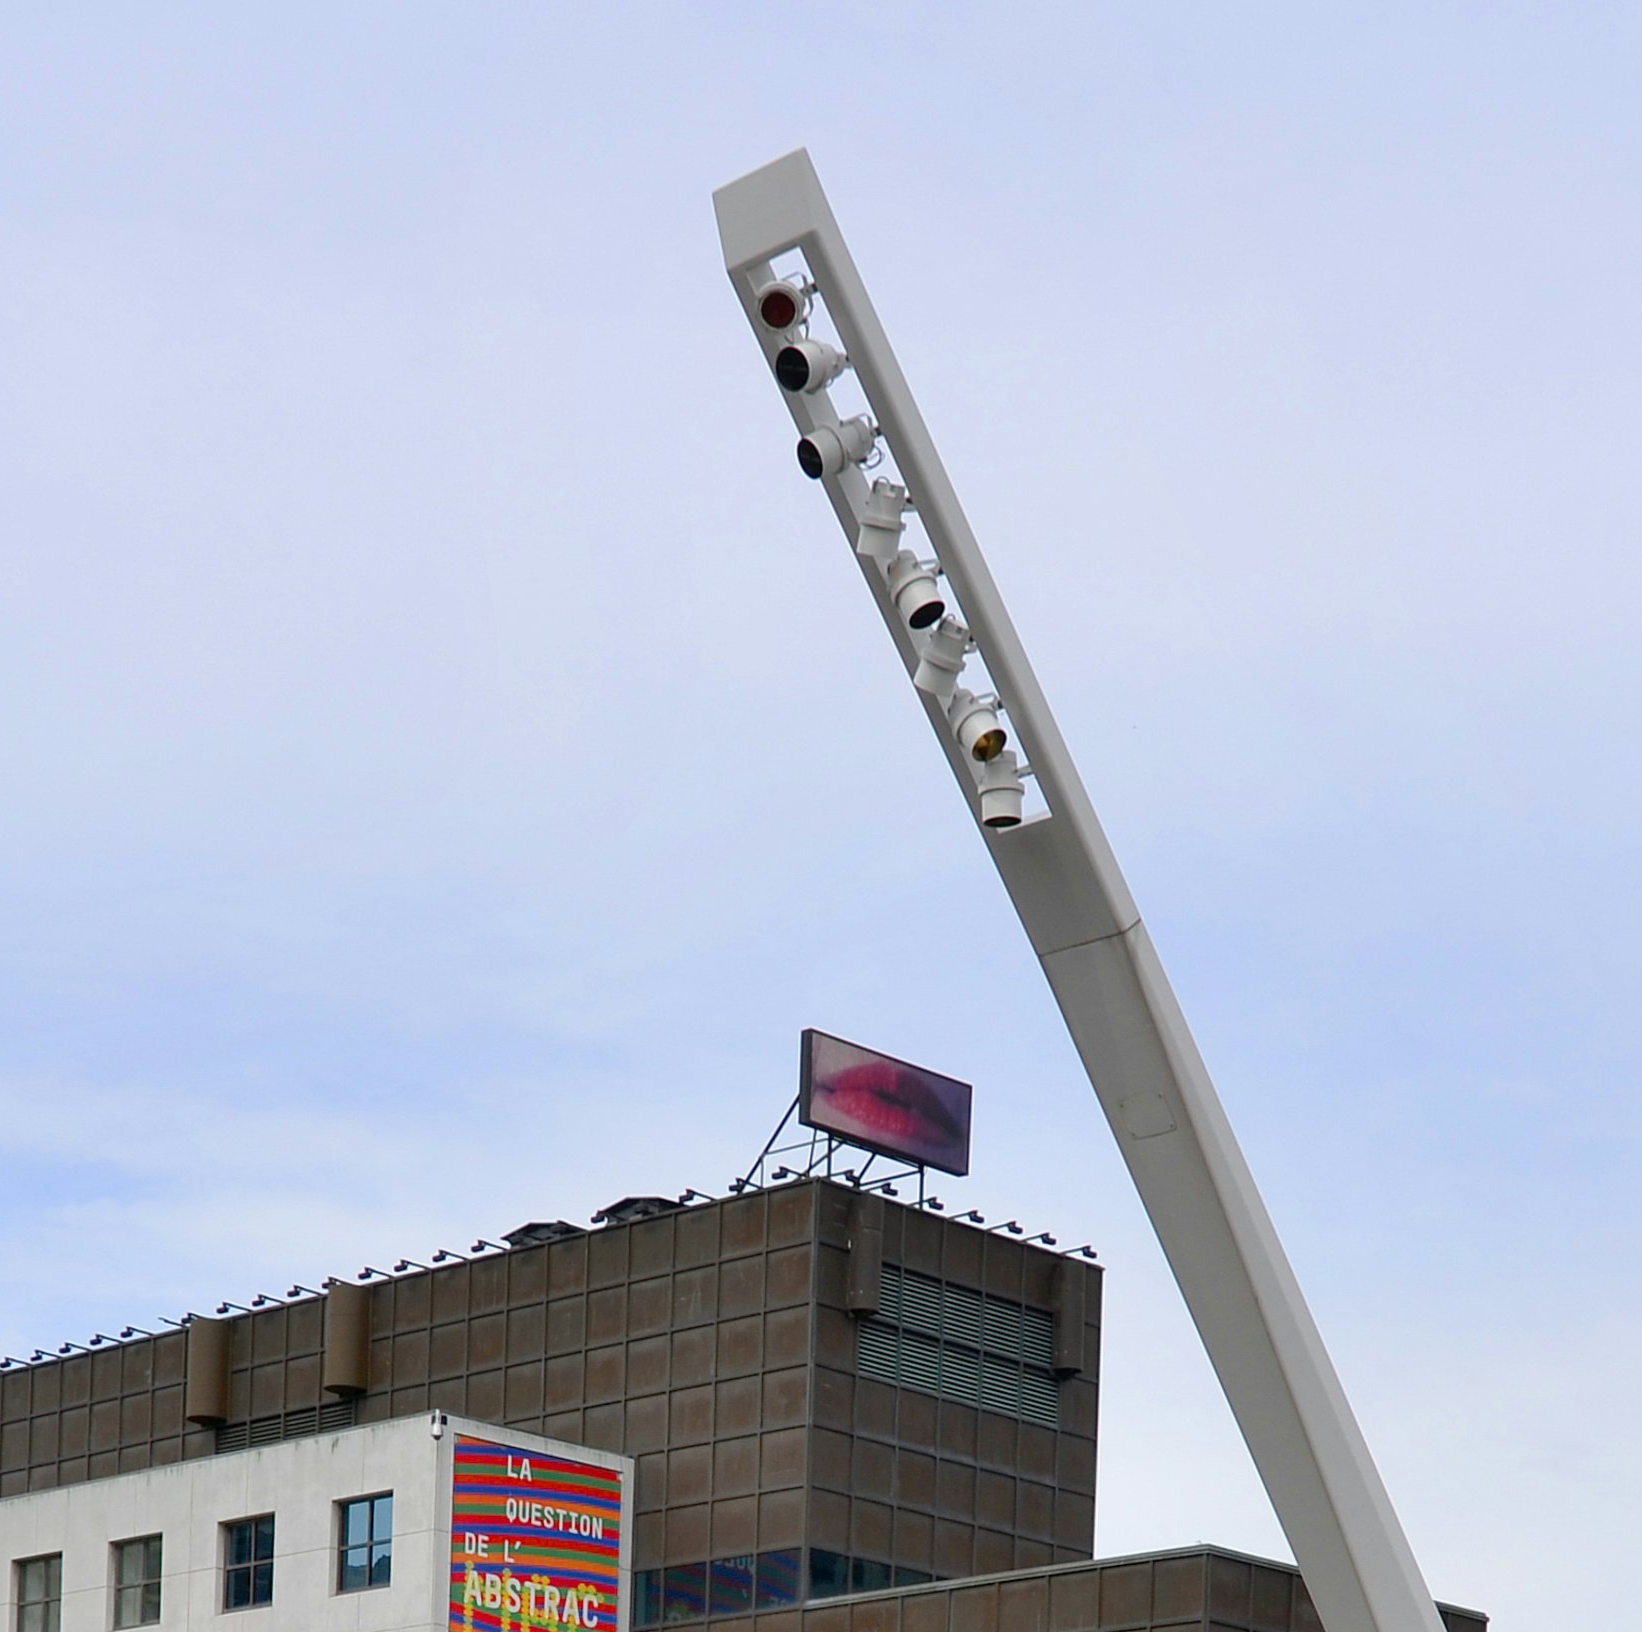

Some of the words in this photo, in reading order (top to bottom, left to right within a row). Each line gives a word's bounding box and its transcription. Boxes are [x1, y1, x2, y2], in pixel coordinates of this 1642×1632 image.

[506, 1454, 532, 1482] LA
[506, 1498, 603, 1540] QUESTION
[464, 1531, 489, 1558] DE
[463, 1570, 599, 1628] ABSTRAC
